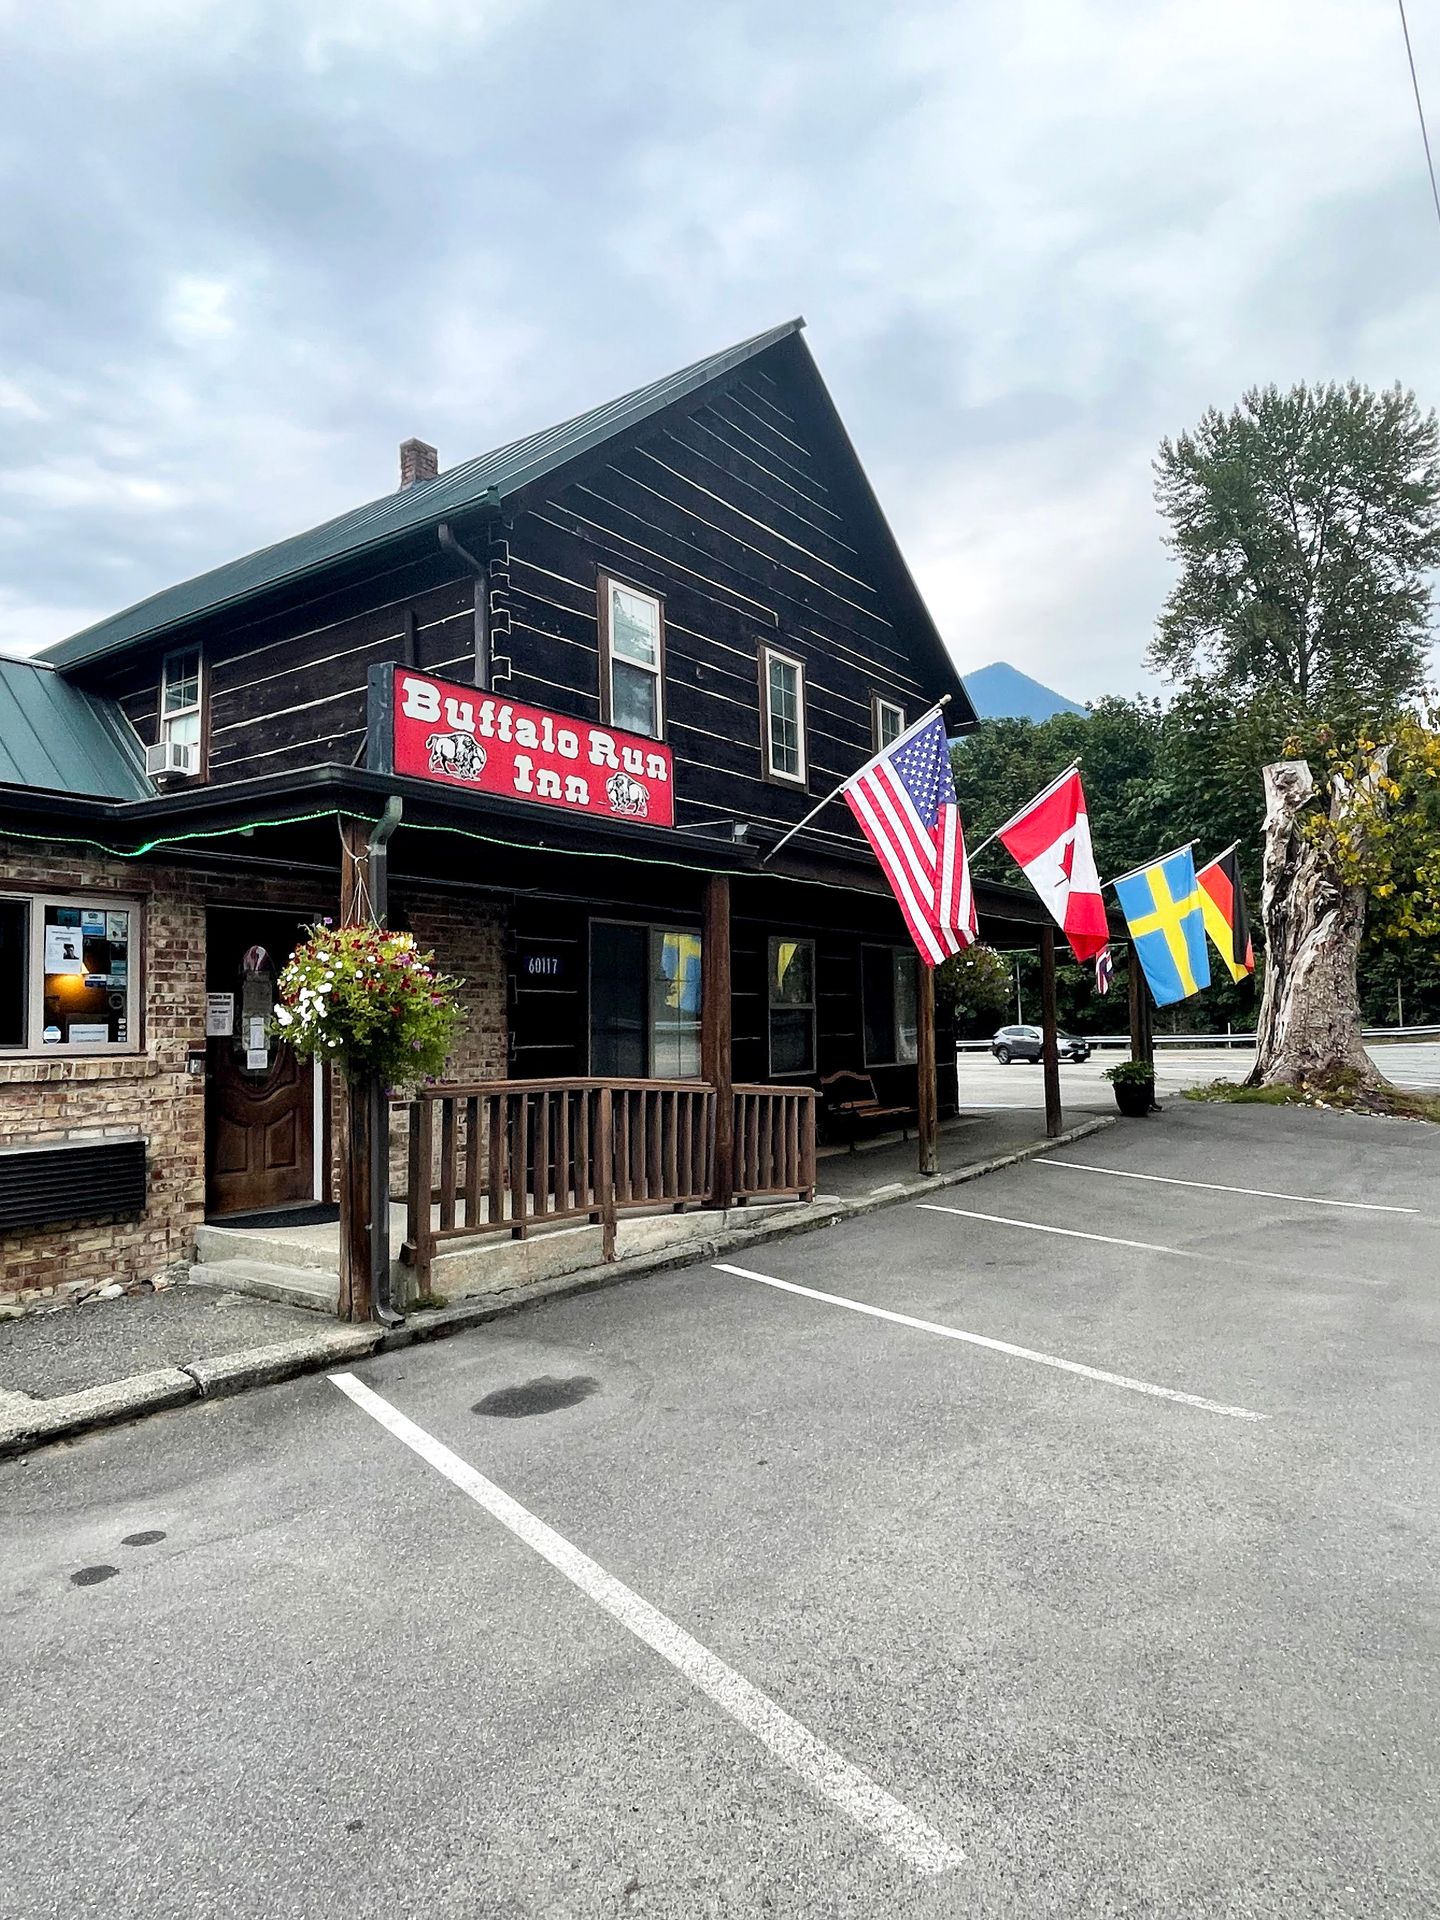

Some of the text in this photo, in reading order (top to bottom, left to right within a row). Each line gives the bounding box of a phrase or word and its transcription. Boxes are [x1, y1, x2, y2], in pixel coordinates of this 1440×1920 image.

[402, 677, 668, 782] Buffalo Run
[513, 754, 590, 805] Inn
[528, 957, 558, 974] 60117
